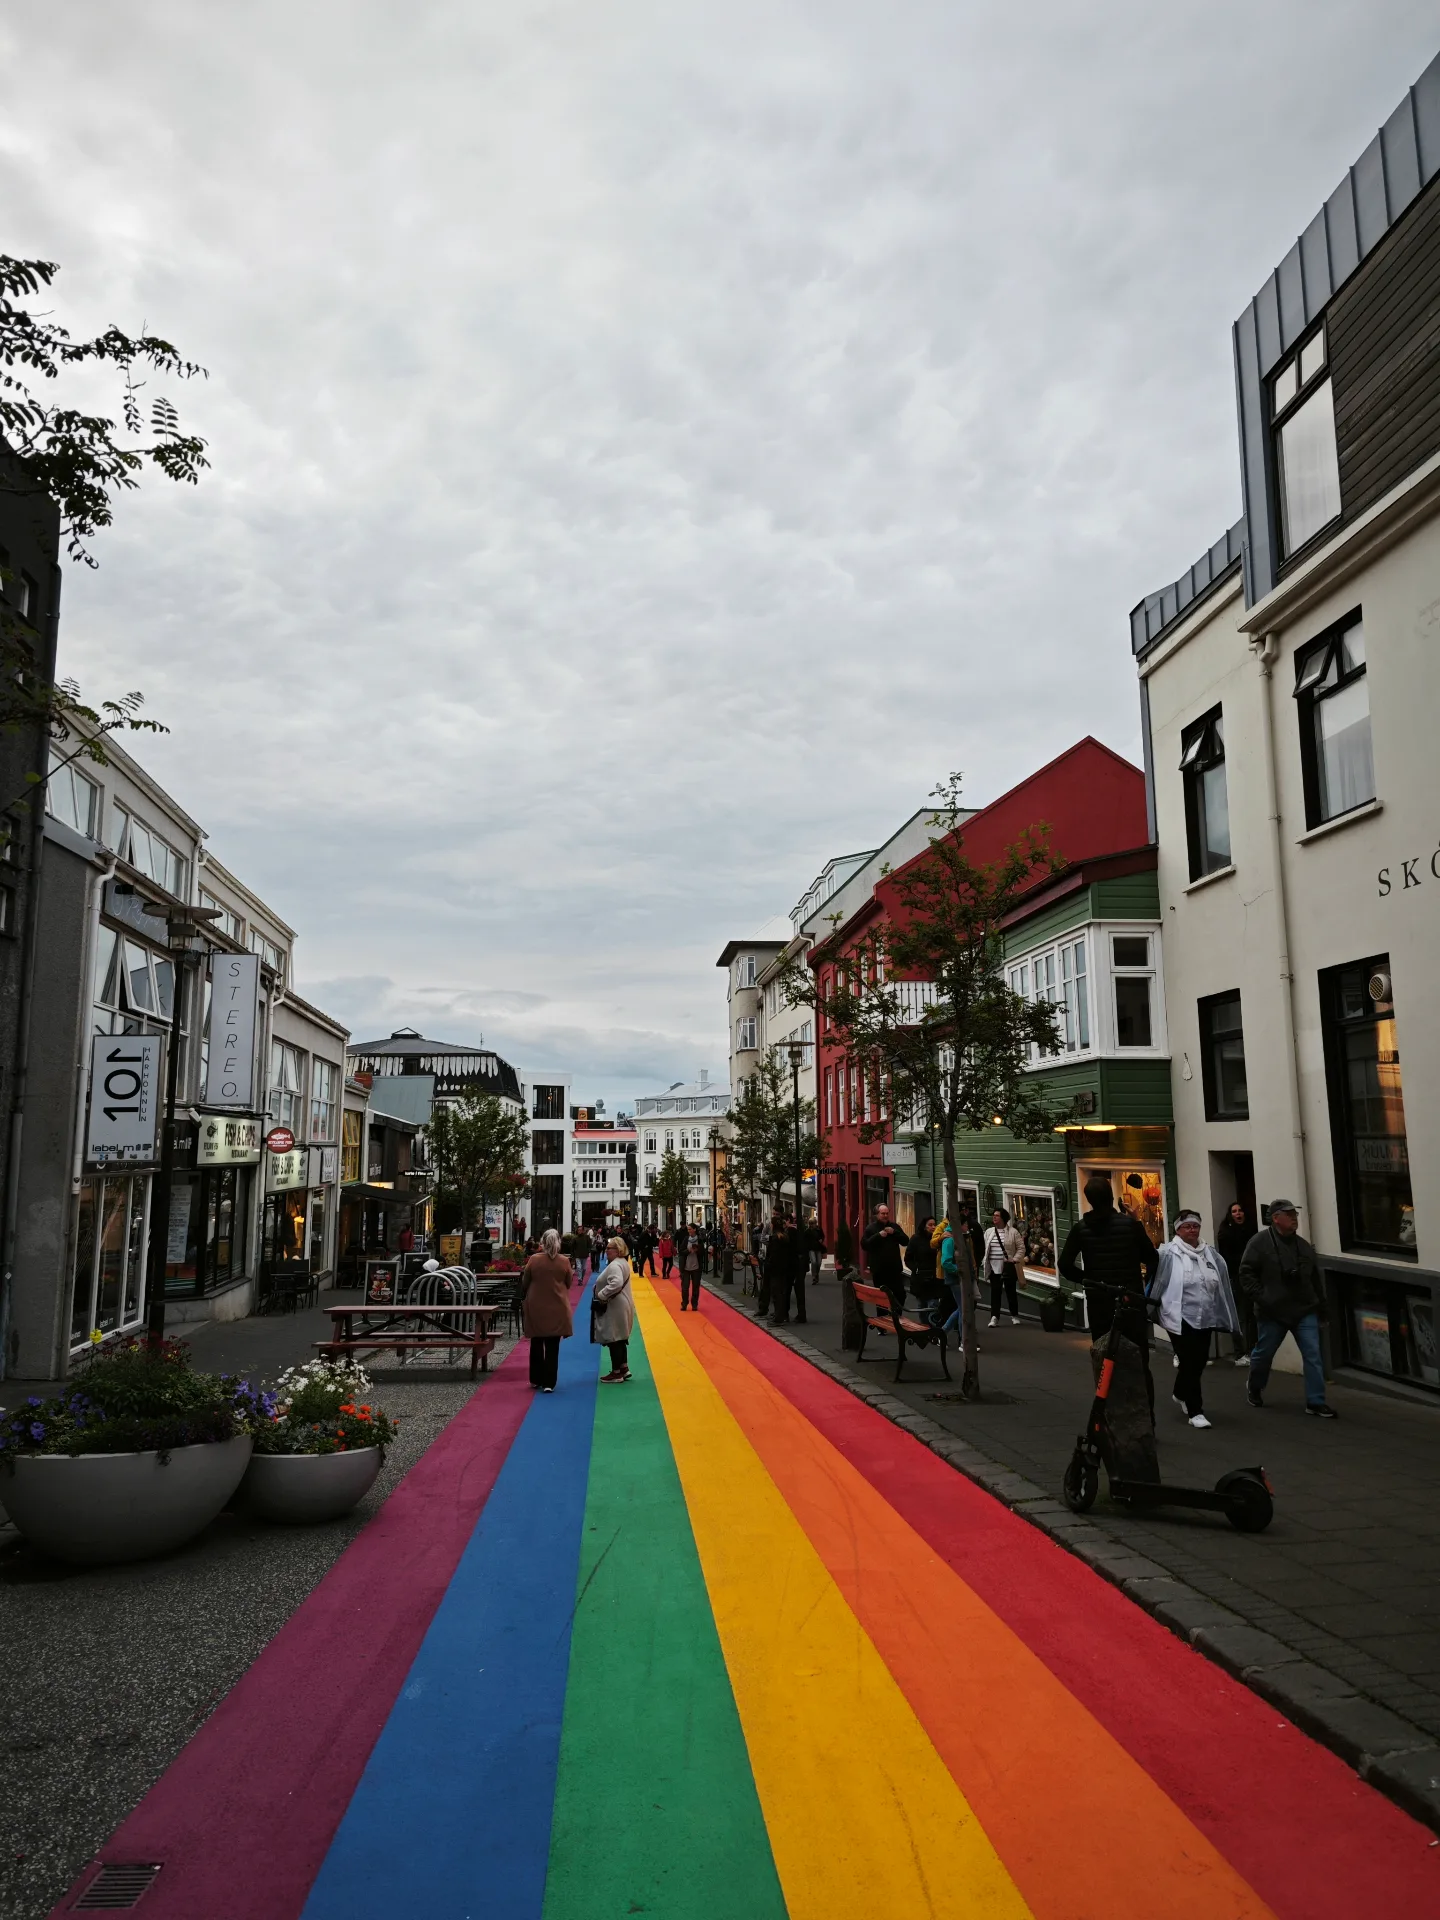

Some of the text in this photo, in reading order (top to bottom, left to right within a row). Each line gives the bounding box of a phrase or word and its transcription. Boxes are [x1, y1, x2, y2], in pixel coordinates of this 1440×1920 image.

[103, 1047, 142, 1122] 101
[225, 1123, 236, 1146] FISH
[241, 1124, 256, 1147] CHIPS
